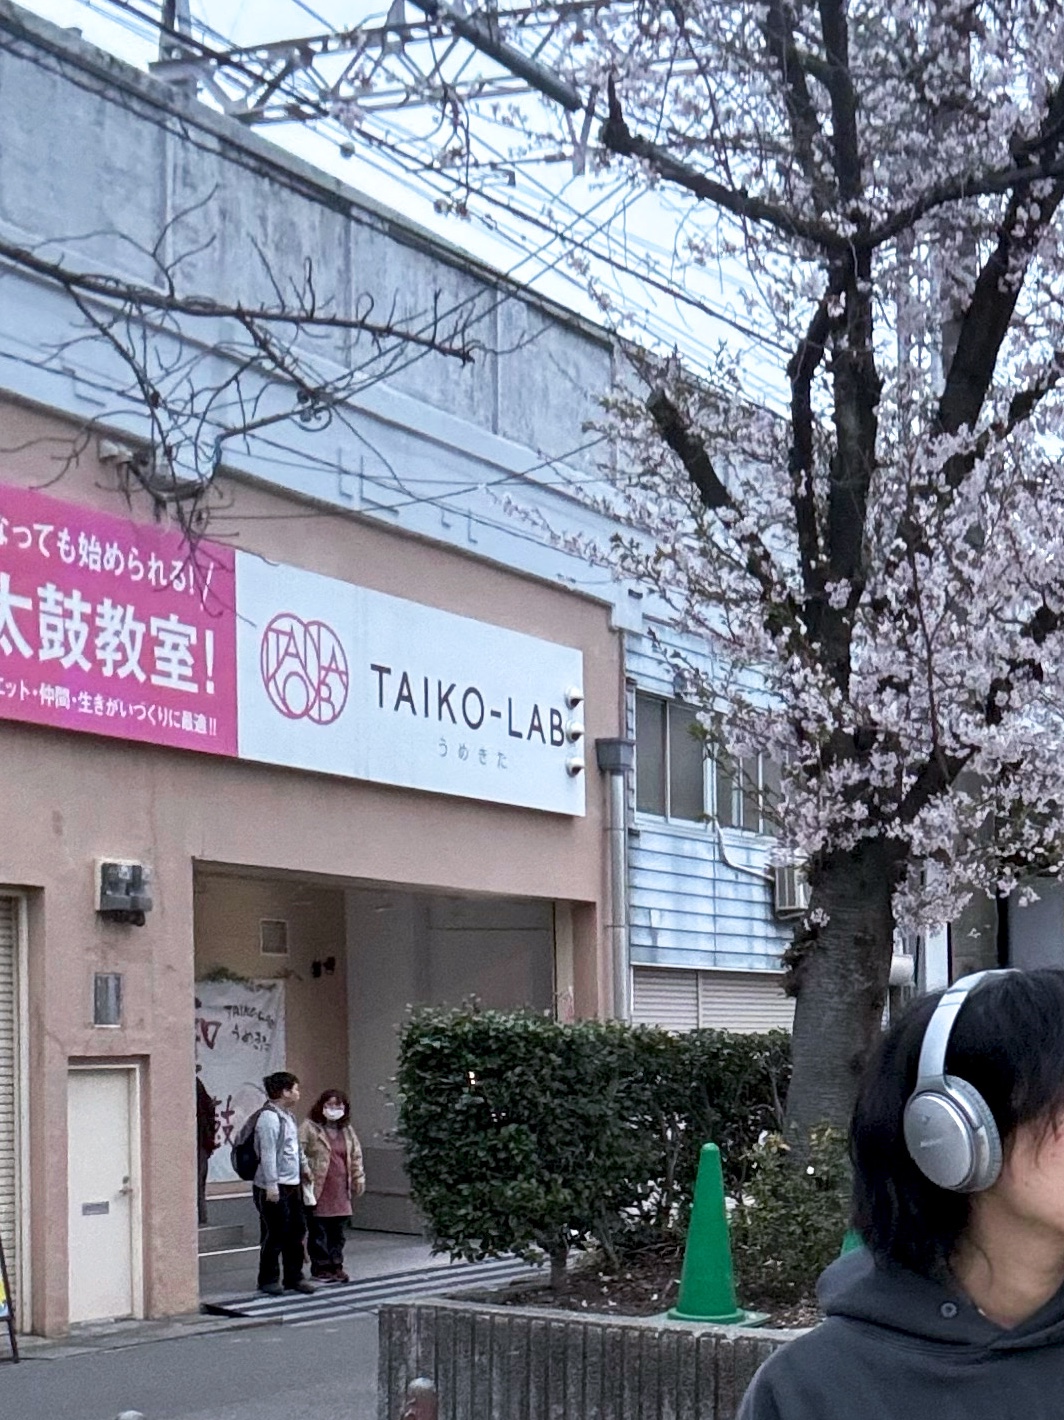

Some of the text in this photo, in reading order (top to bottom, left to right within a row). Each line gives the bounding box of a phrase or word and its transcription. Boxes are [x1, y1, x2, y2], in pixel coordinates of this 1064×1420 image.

[370, 663, 566, 748] TAIKO-LAB
[438, 737, 509, 769] うめきた
